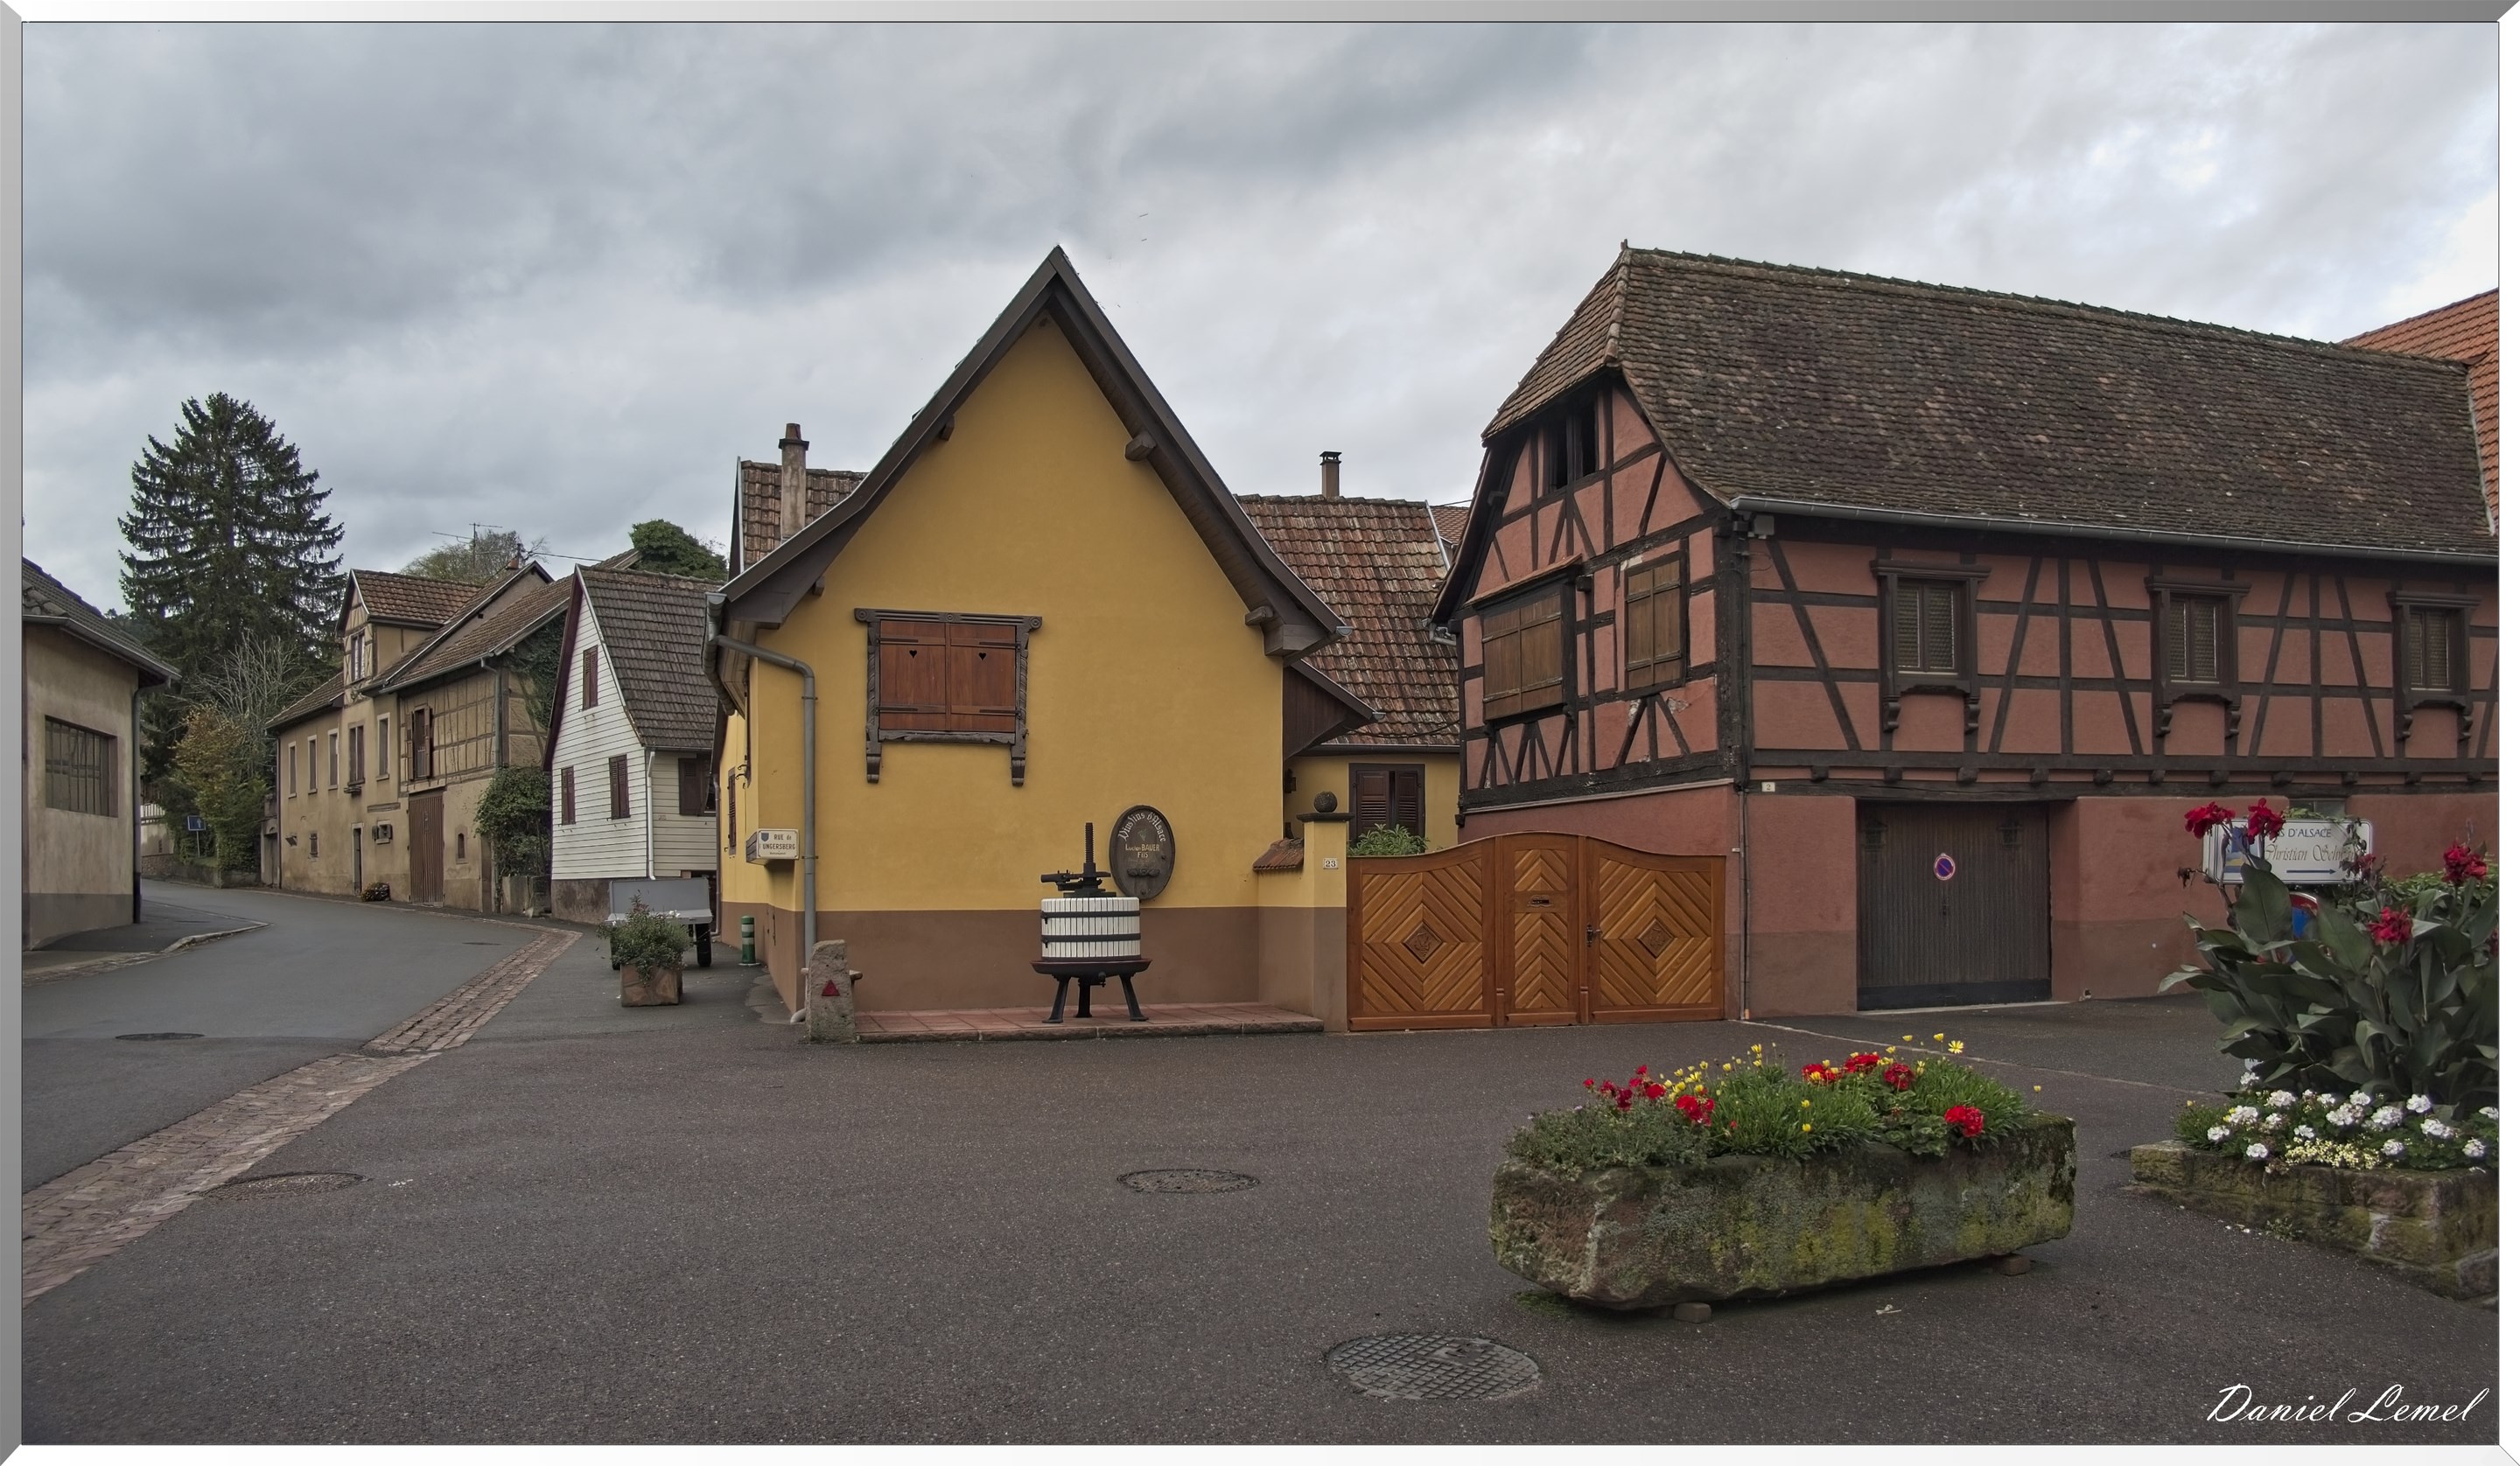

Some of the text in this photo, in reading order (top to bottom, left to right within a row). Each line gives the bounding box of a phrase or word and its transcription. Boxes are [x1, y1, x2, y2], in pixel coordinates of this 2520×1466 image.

[1117, 820, 1134, 841] Vins
[2287, 827, 2332, 838] D'ALSACE
[1141, 843, 1160, 852] BAUER
[2264, 843, 2308, 862] Christian
